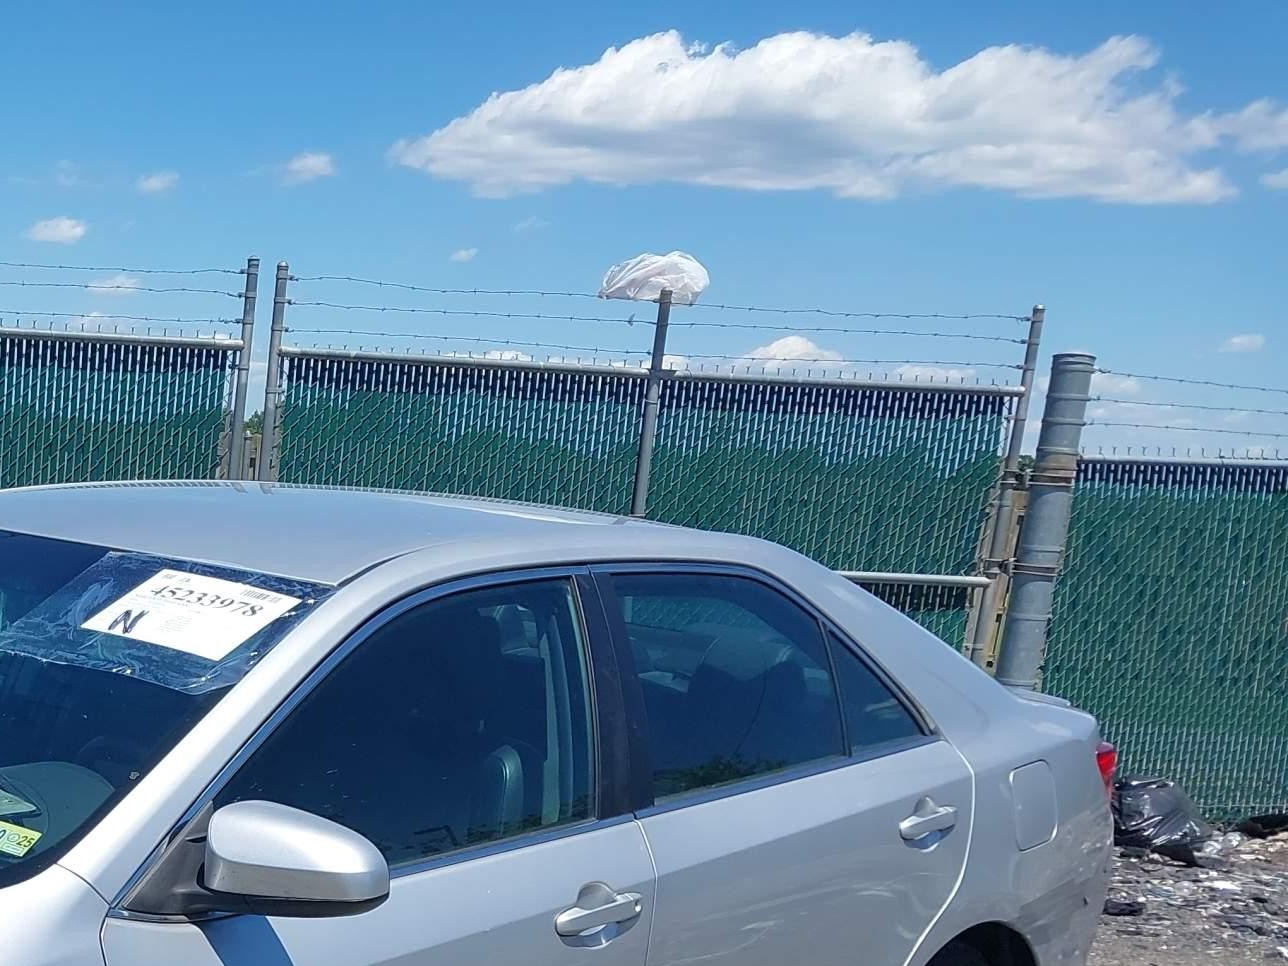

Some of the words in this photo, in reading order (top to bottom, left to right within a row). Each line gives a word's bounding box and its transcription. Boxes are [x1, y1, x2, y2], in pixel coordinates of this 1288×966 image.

[150, 585, 264, 617] 45233978
[108, 609, 150, 634] N
[16, 835, 35, 848] 25
